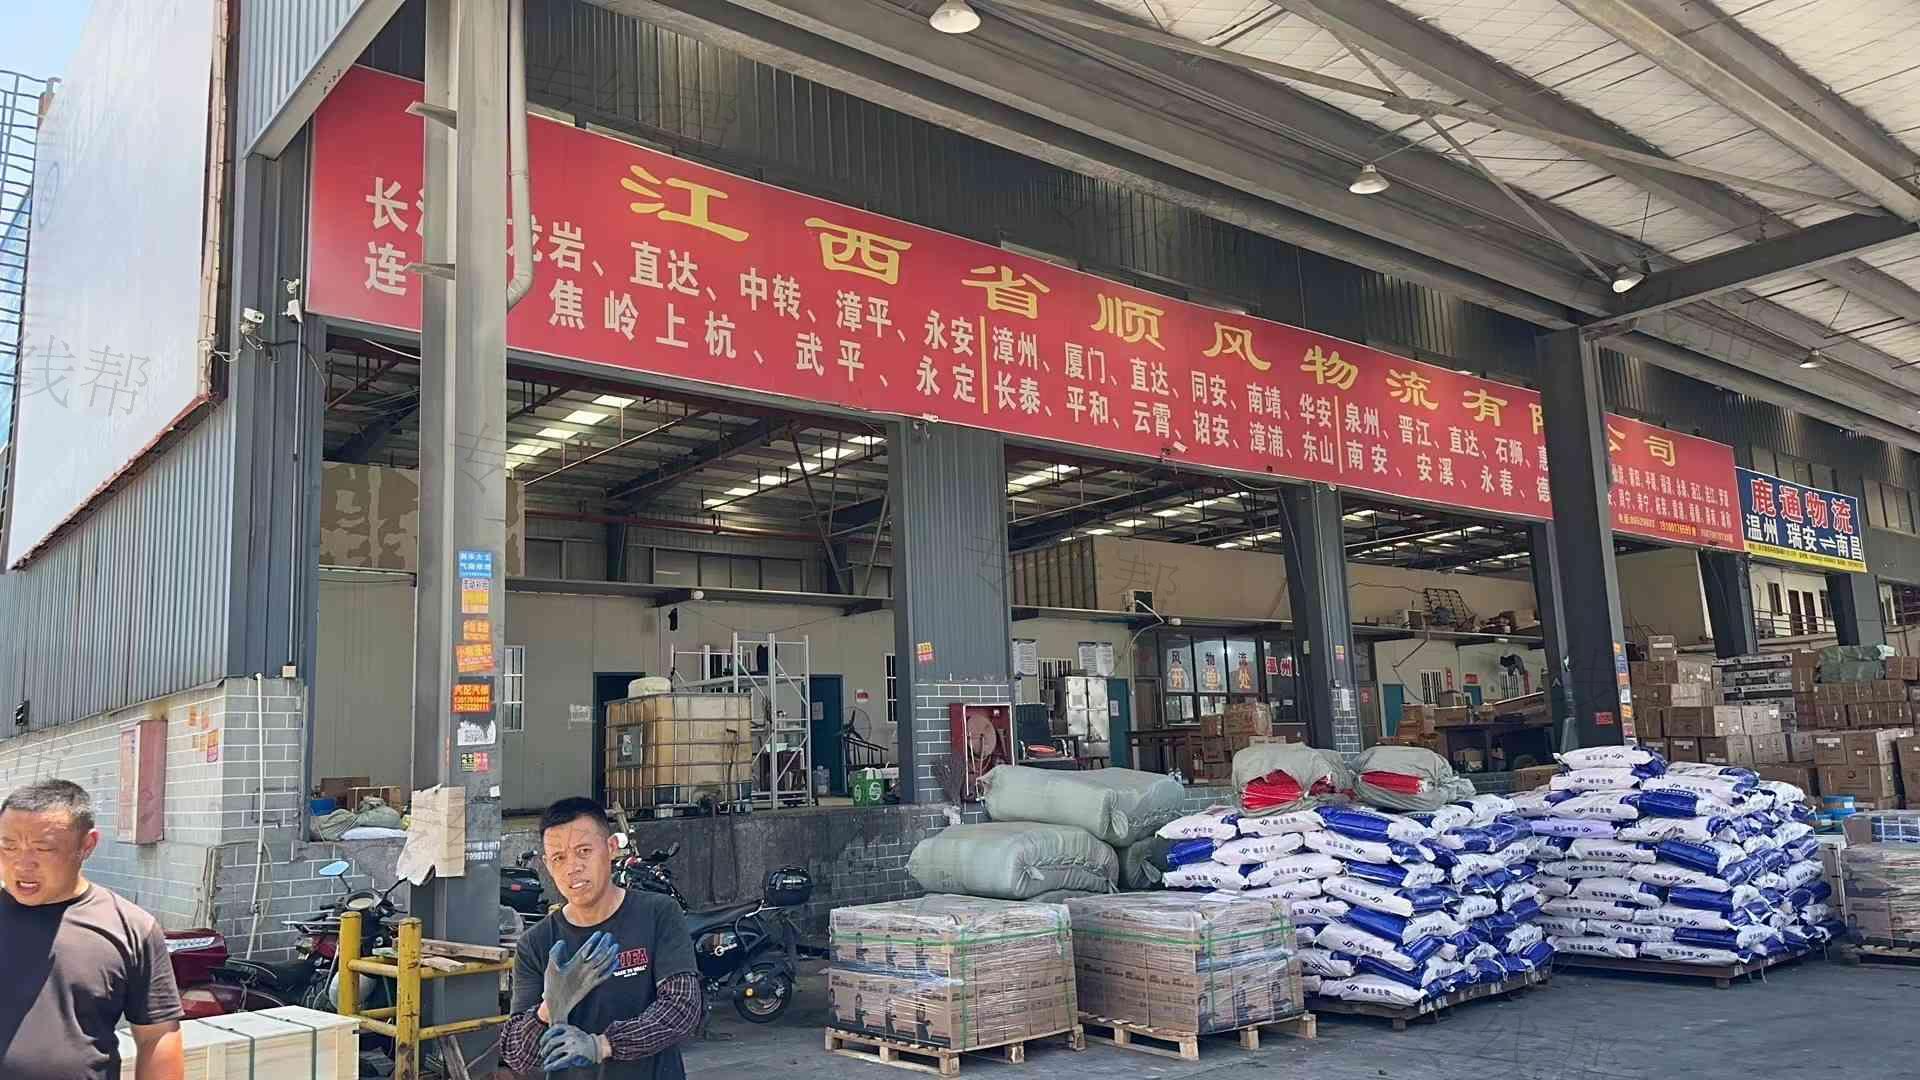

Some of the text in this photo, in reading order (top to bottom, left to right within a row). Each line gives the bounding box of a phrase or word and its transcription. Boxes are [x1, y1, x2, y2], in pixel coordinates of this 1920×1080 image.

[1751, 478, 1853, 534] 鹿通物流
[1746, 513, 1778, 545] 温州
[1786, 523, 1817, 552] 瑞安
[1835, 532, 1863, 561] 南昌
